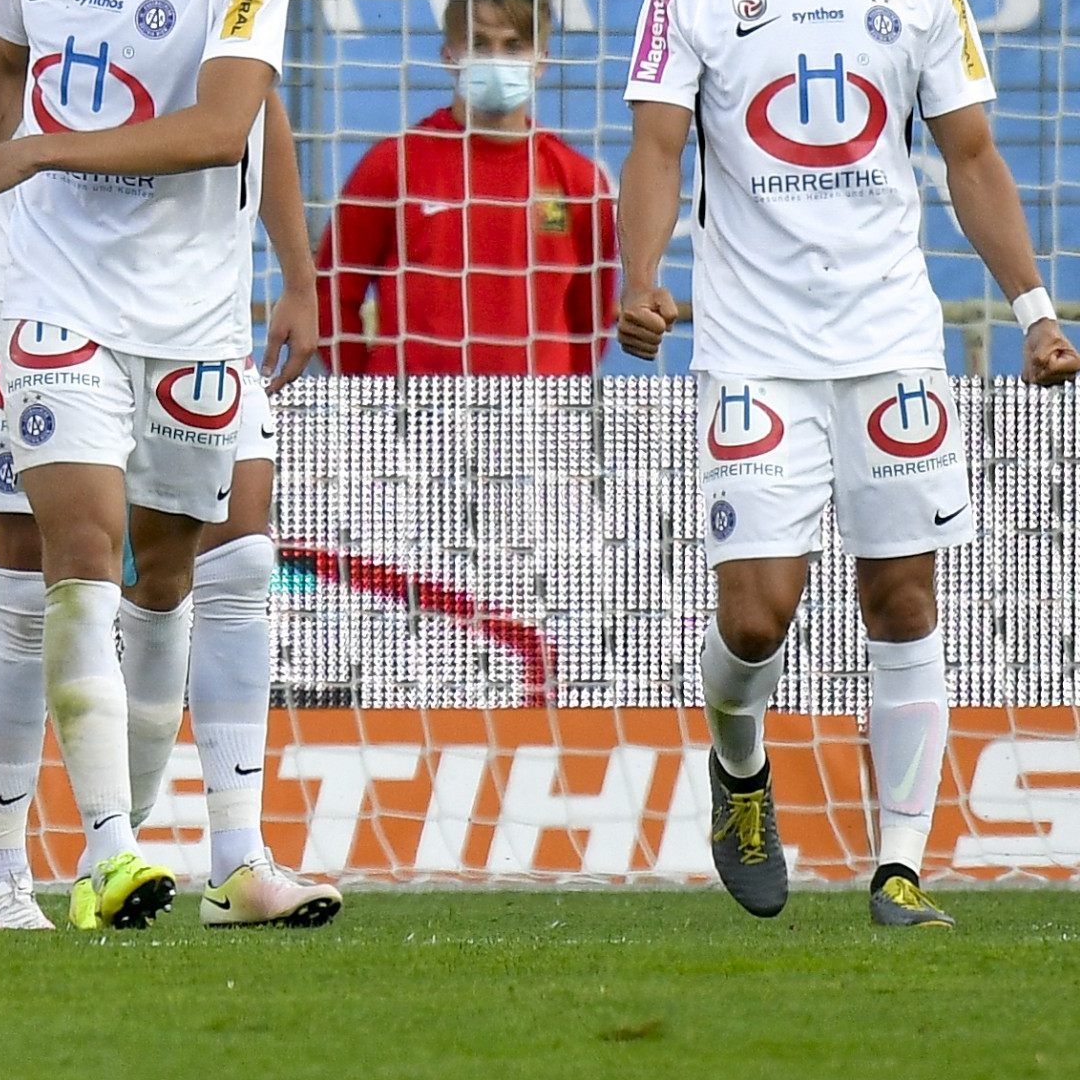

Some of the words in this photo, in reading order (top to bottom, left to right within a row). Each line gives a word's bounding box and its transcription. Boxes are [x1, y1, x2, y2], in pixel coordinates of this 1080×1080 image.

[791, 7, 845, 24] synthos
[7, 372, 101, 394] HARREITHER
[872, 453, 958, 479] HARREITHER
